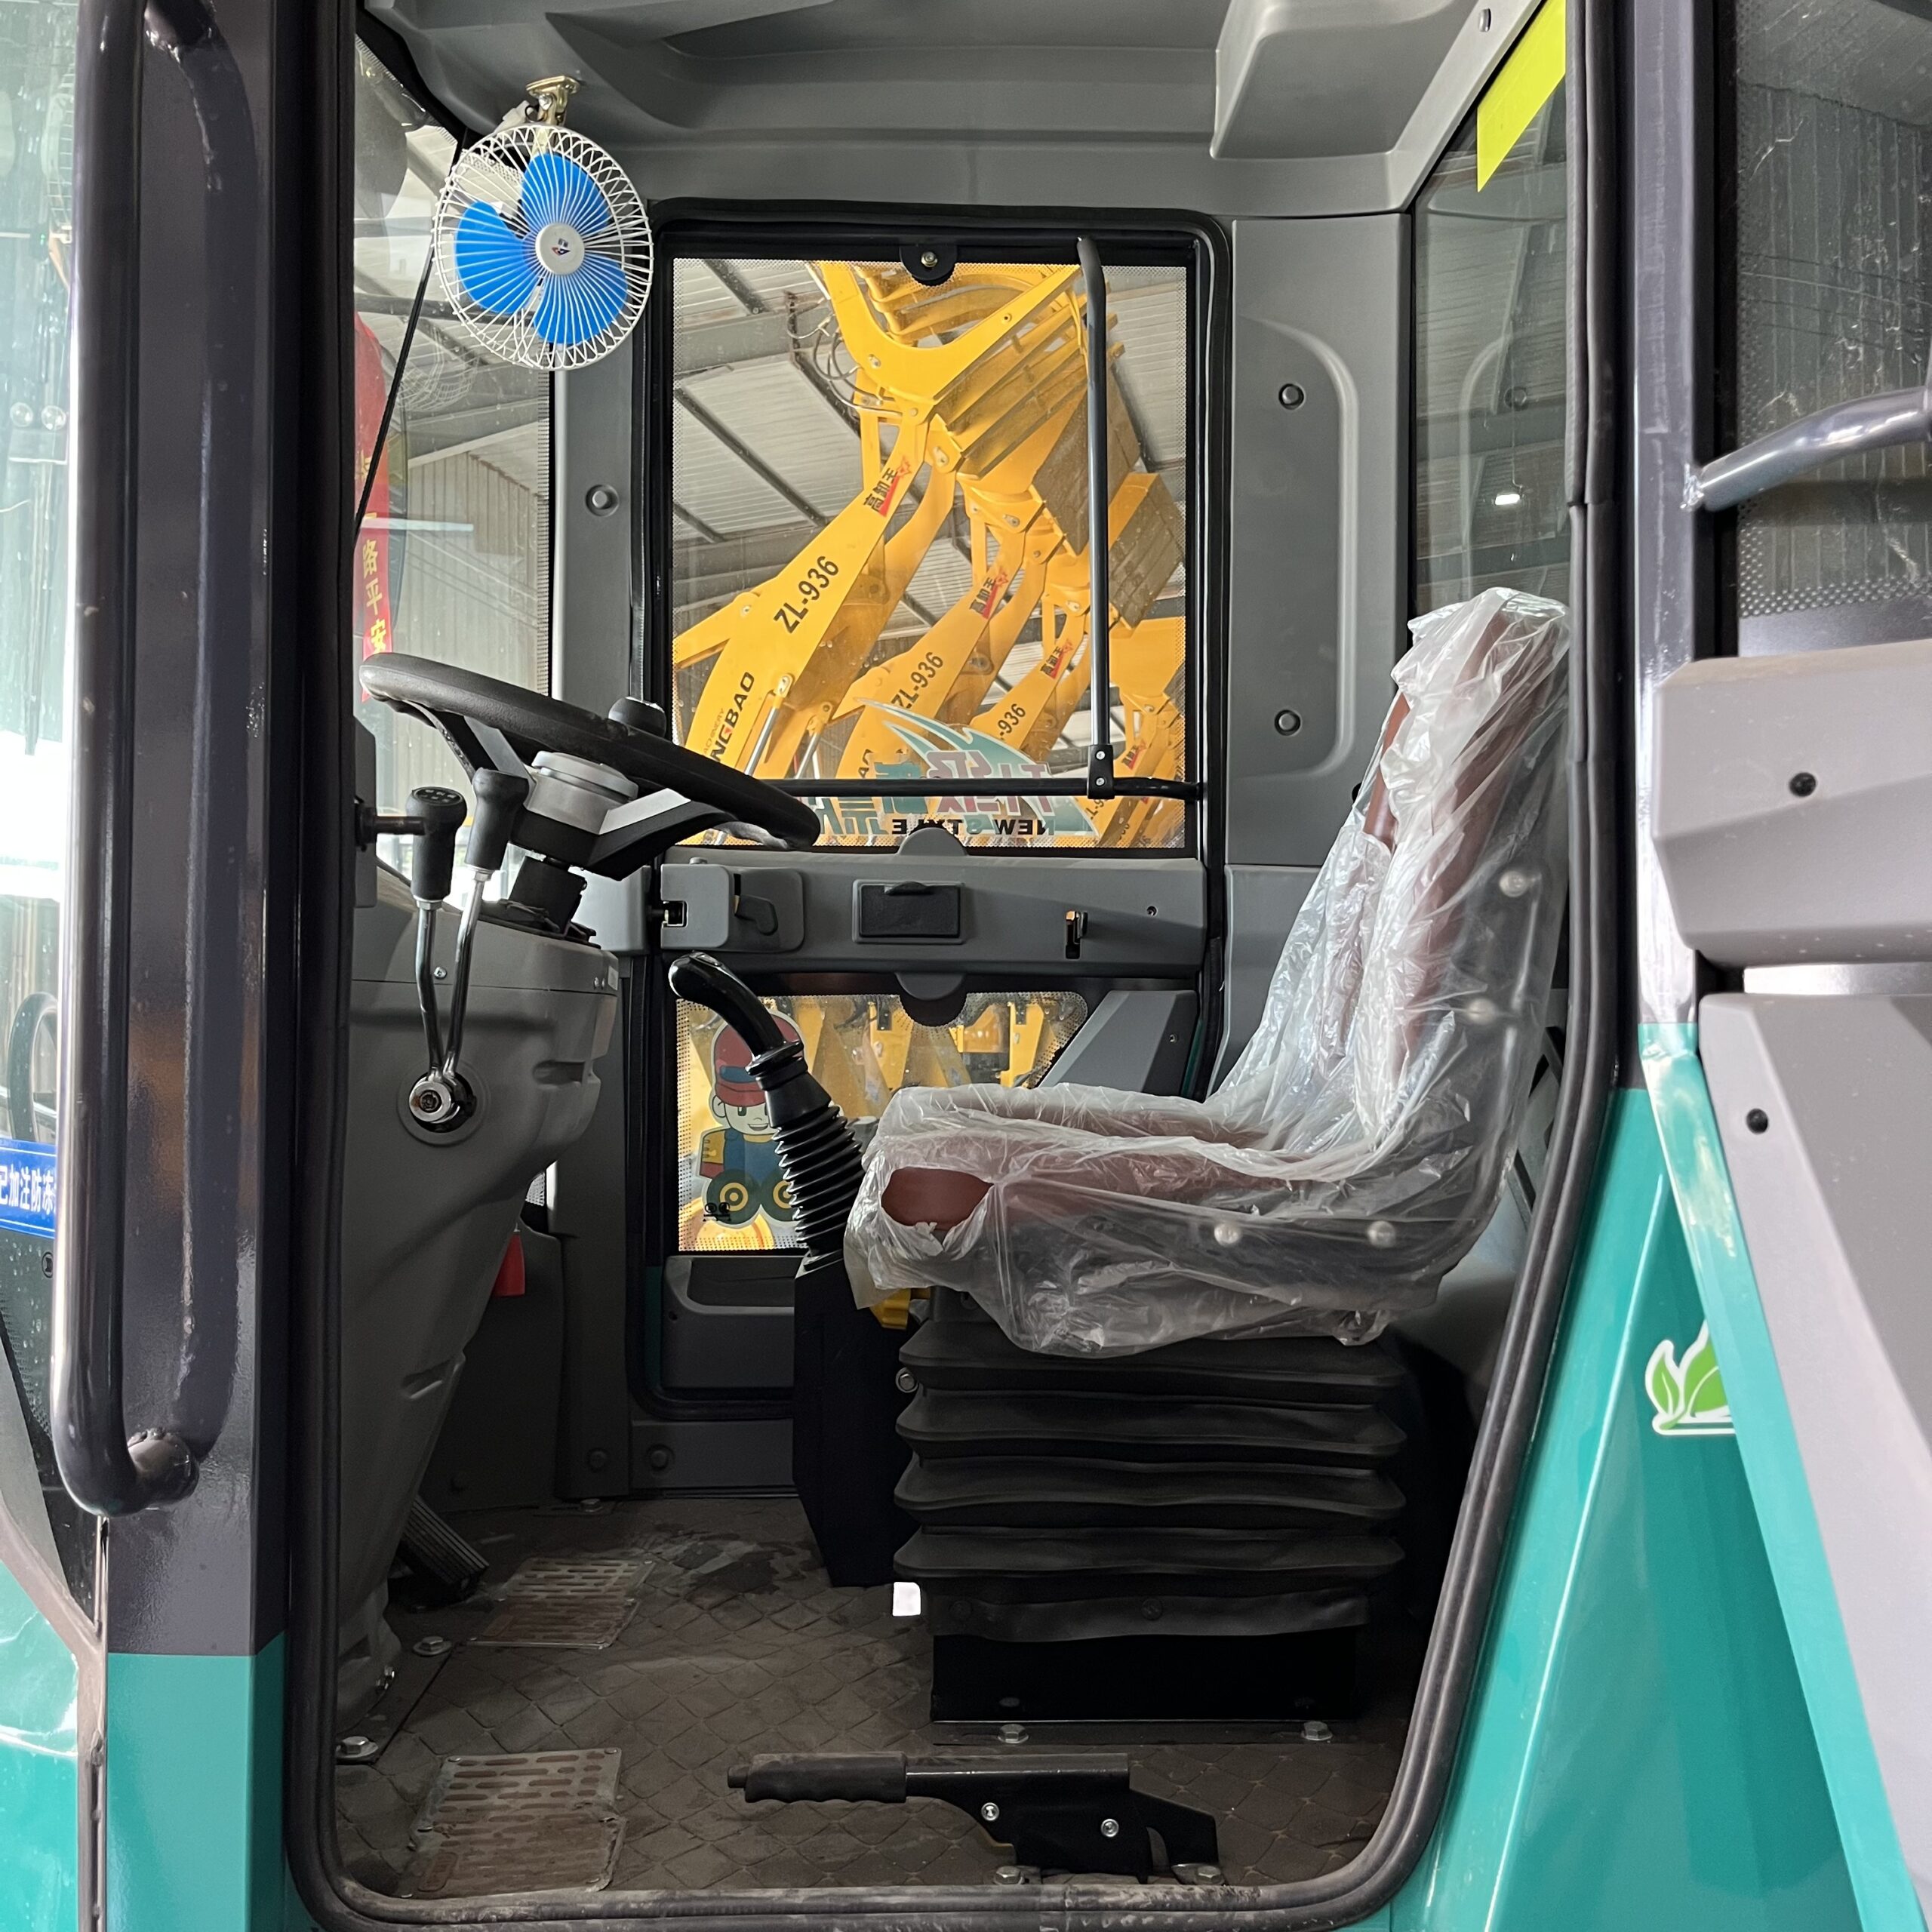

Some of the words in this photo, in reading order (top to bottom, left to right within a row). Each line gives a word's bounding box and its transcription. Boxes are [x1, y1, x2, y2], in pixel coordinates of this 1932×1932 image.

[863, 467, 898, 513] 高卸王
[773, 555, 839, 634] ZL-936
[891, 651, 944, 709] ZL-936
[710, 672, 755, 762] NGBAO
[998, 703, 1026, 740] -936
[0, 1163, 57, 1216] 已加注防冻
